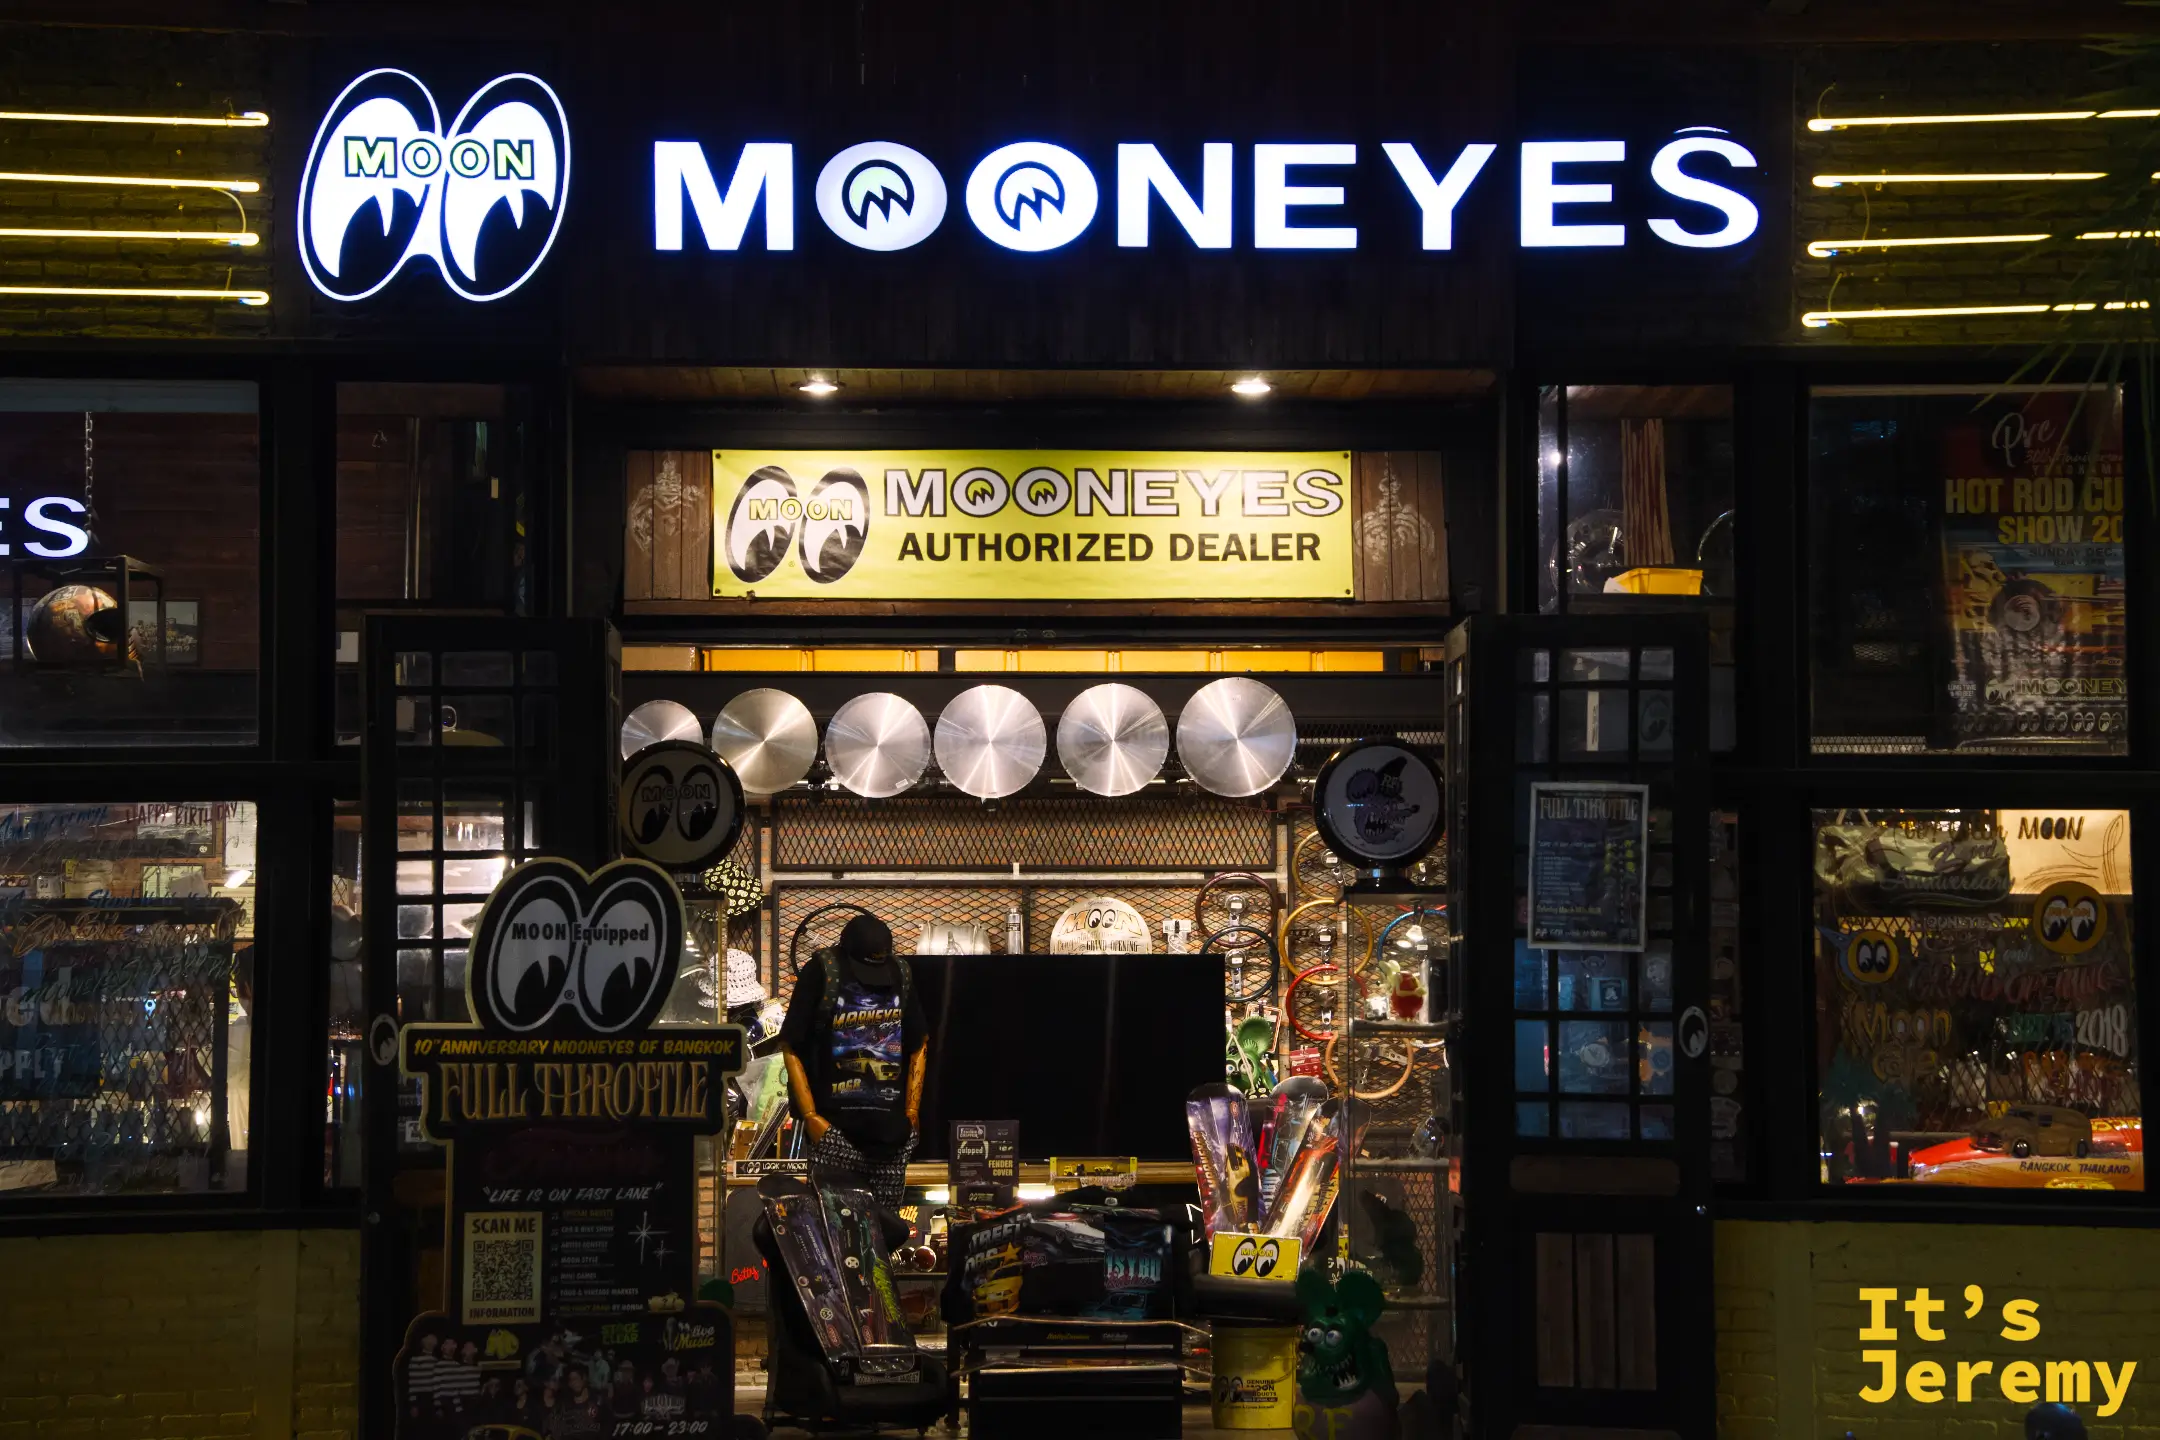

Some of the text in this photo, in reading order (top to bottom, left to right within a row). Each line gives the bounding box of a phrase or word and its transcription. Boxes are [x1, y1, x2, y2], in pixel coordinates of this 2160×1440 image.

[344, 135, 536, 180] MOON
[654, 135, 1760, 252] MOONEYES
[885, 467, 1343, 518] MOONEYES
[1945, 477, 2005, 514] HOT
[2012, 476, 2074, 513] ROD
[749, 498, 853, 521] MOON
[0, 496, 90, 557] S
[1998, 515, 2084, 544] SHOW
[897, 532, 1322, 563] AUTHORIZED DEALER
[641, 784, 711, 803] MOON
[126, 803, 173, 825] HAPPY
[2018, 816, 2084, 840] MOON
[512, 922, 649, 945] MOON Equipped
[1851, 1002, 1952, 1046] Moon
[2076, 1004, 2129, 1058] 2018
[553, 1039, 635, 1055] MOONEYES
[639, 1039, 656, 1055] OF
[663, 1039, 735, 1056] BANGKOK
[437, 1060, 709, 1123] FULL THROTTLE
[988, 1160, 1013, 1169] FENDER
[993, 1169, 1013, 1177] COVER
[2019, 1161, 2130, 1174] BANGKOK THAILAND
[526, 1188, 543, 1202] IS
[549, 1187, 568, 1202] ON
[575, 1186, 613, 1201] FAST
[472, 1218, 536, 1234] SCAN ME
[579, 1256, 598, 1264] STYLE
[1241, 1248, 1274, 1257] MOON
[611, 1287, 639, 1296] MARKETS
[469, 1305, 535, 1319] INFORMATION
[621, 1303, 643, 1311] HONDA
[668, 1420, 708, 1436] 23:00
